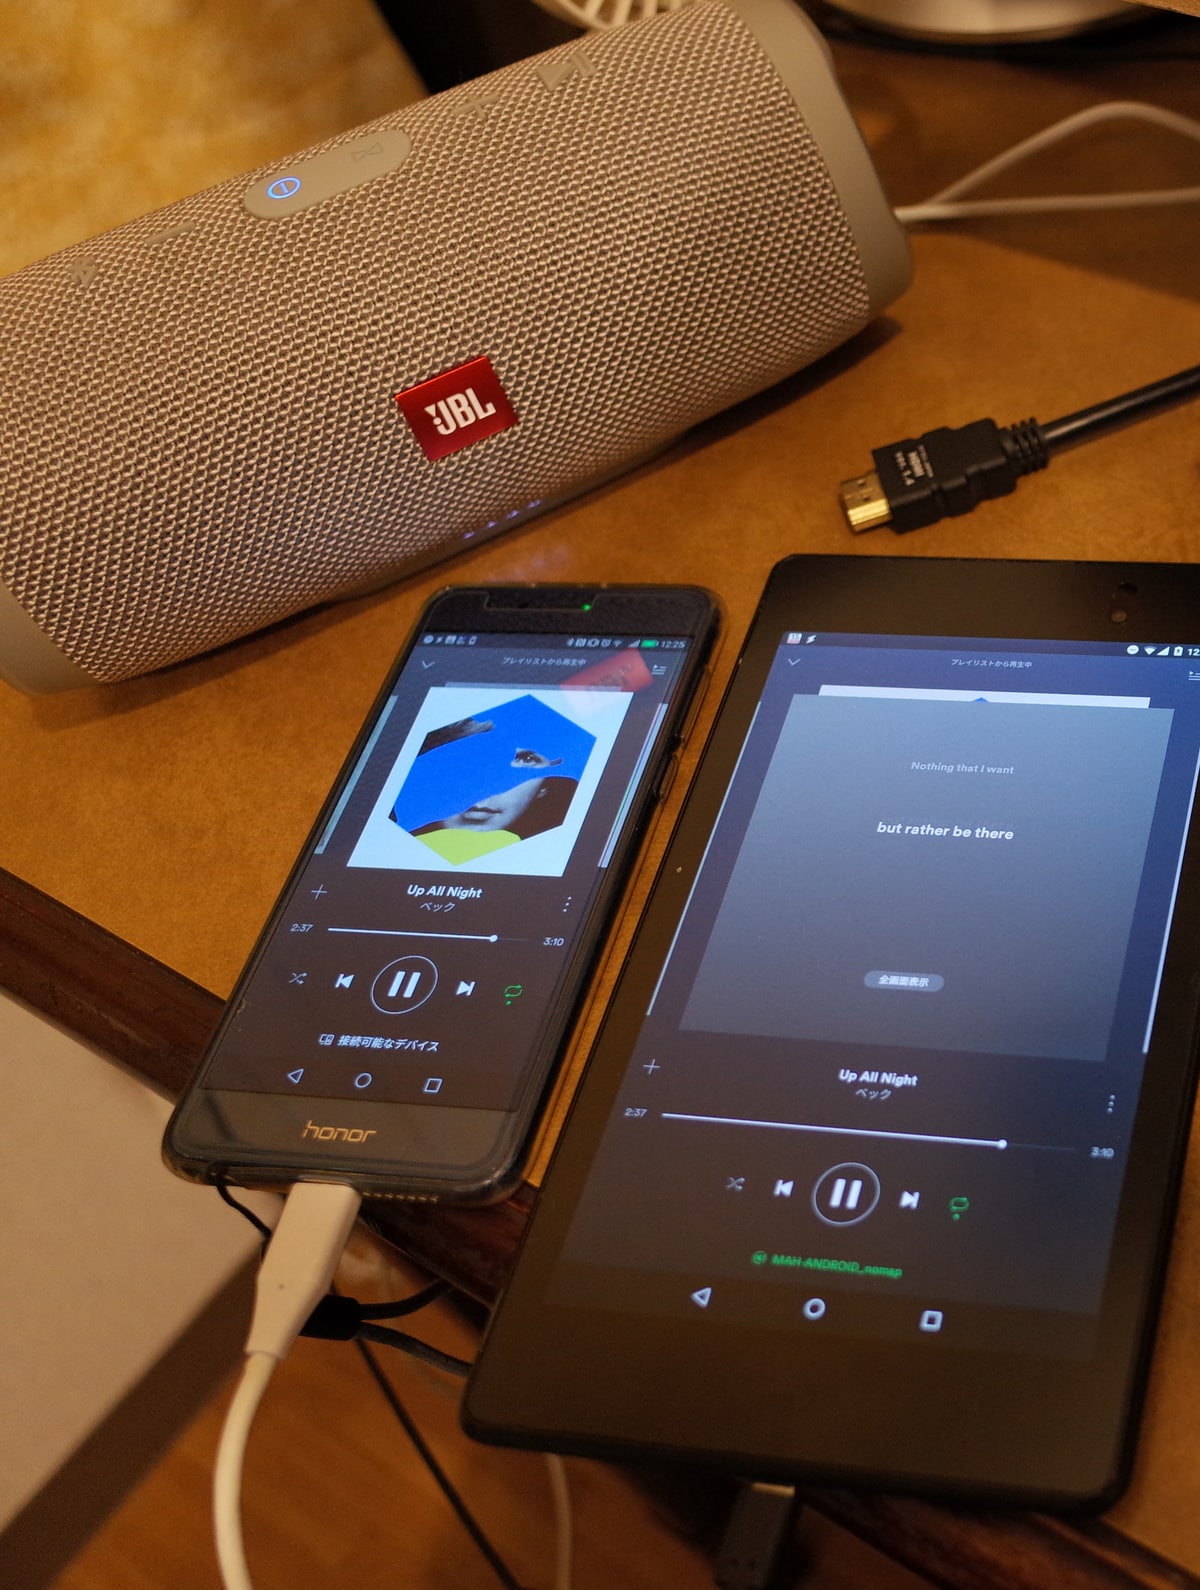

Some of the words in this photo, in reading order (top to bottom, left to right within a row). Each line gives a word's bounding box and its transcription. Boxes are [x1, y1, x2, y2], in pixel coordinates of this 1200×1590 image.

[424, 388, 496, 435] JBL
[661, 640, 686, 649] 12:25
[503, 657, 587, 666] プレイリストから再生中
[951, 658, 1033, 669] プレイリストから再生中
[911, 761, 954, 774] Nothing
[956, 763, 979, 773] that
[987, 765, 1014, 775] want
[876, 821, 901, 834] but
[905, 824, 950, 836] rather
[953, 825, 972, 838] be
[974, 827, 1014, 840] there
[407, 884, 425, 897] Up
[427, 885, 445, 897] All
[447, 886, 483, 899] Night
[420, 901, 455, 913] ベック
[290, 924, 313, 933] 2:37
[543, 936, 565, 947] 3:10
[878, 974, 930, 988] 全画面表示
[337, 1035, 439, 1053] 接続可能なデバイス
[839, 1068, 857, 1084] Up
[860, 1070, 878, 1083] All
[880, 1071, 918, 1088] Night
[855, 1086, 892, 1100] ベック
[624, 1106, 647, 1119] 2:37
[302, 1120, 377, 1143] honor
[1091, 1146, 1115, 1159] 3:10
